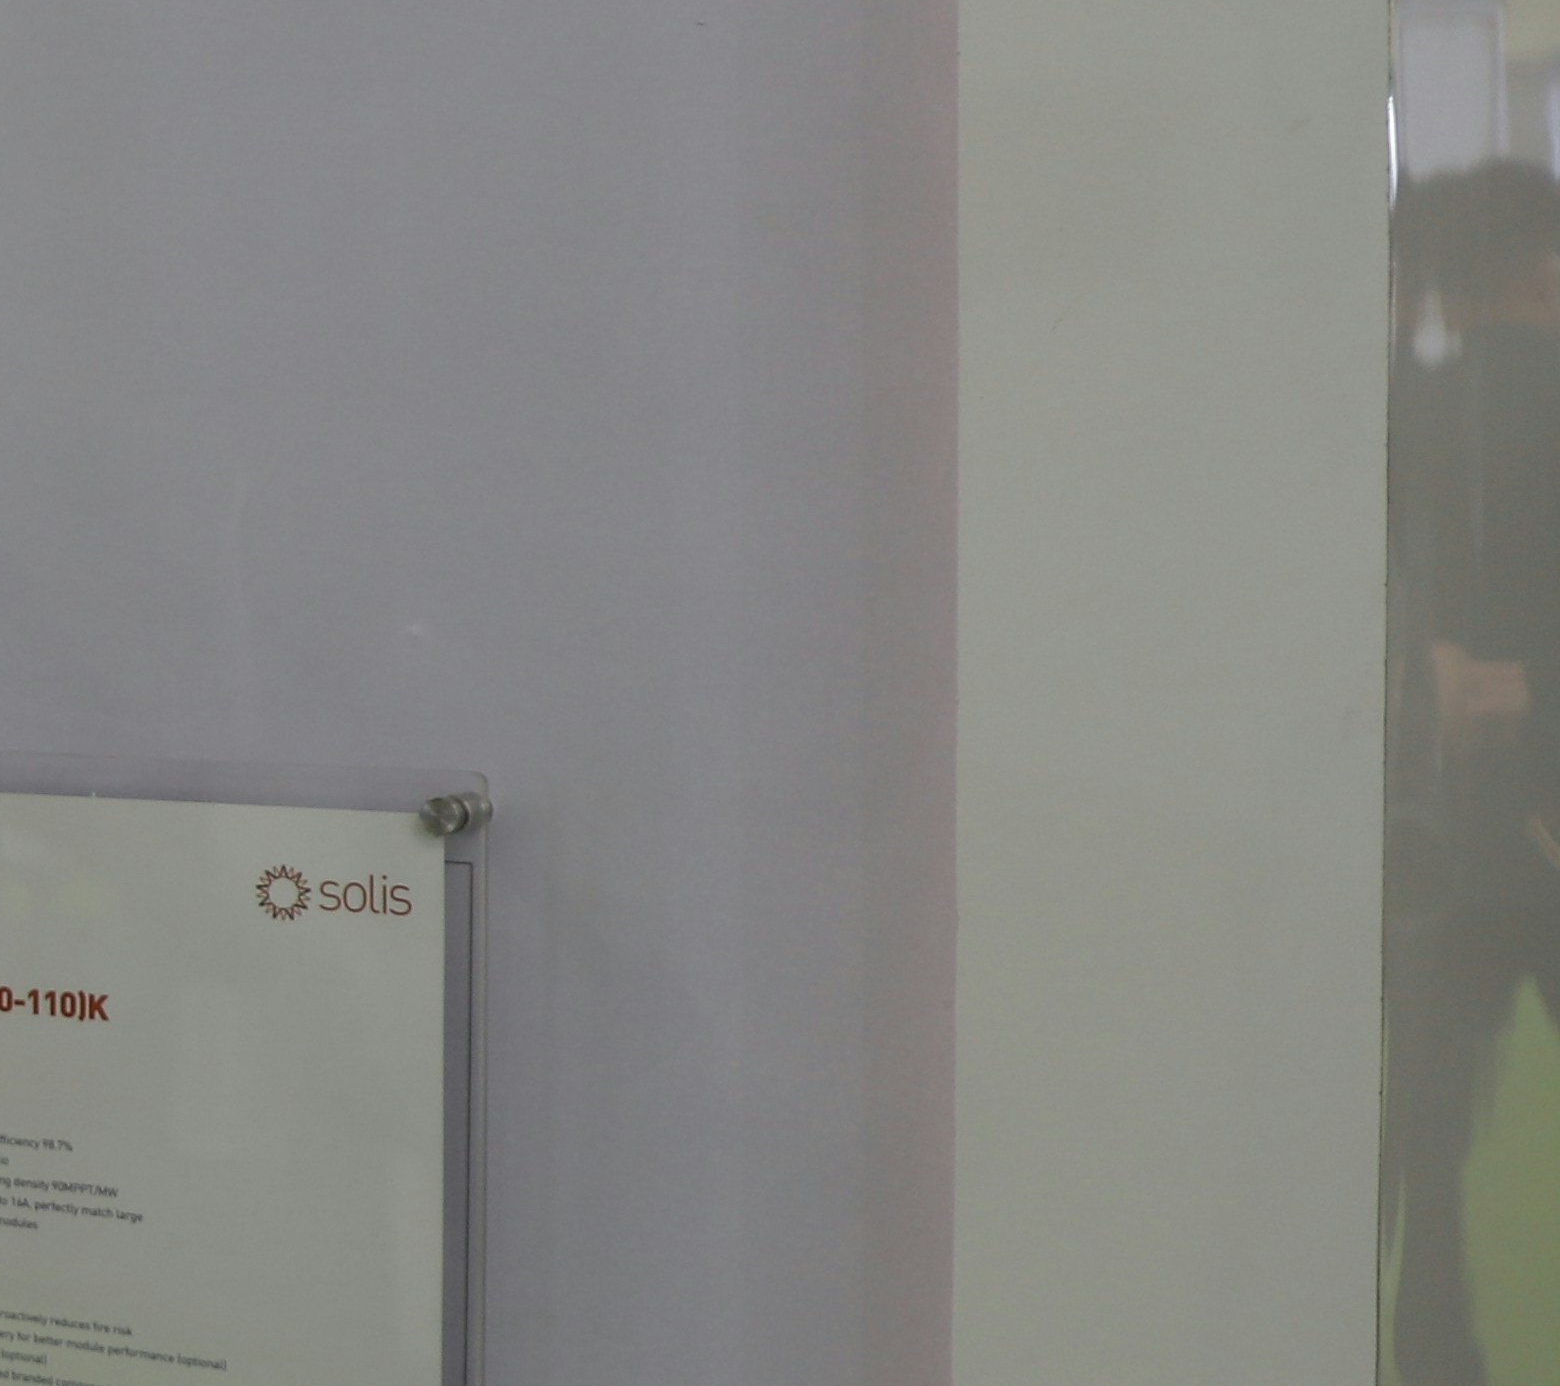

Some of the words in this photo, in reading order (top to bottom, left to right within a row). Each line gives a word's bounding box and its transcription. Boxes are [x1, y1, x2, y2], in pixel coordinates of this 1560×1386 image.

[318, 874, 414, 916] solis
[13, 1177, 49, 1191] density
[34, 1199, 79, 1215] perfectly
[81, 1205, 113, 1217] match
[116, 1211, 144, 1224] large
[50, 1315, 90, 1330] reduces
[92, 1321, 110, 1333] fire
[112, 1324, 133, 1336] risk
[17, 1329, 31, 1341] for
[33, 1332, 63, 1346] better
[66, 1339, 105, 1353] module
[107, 1344, 174, 1363] performance
[11, 1370, 53, 1386] branded
